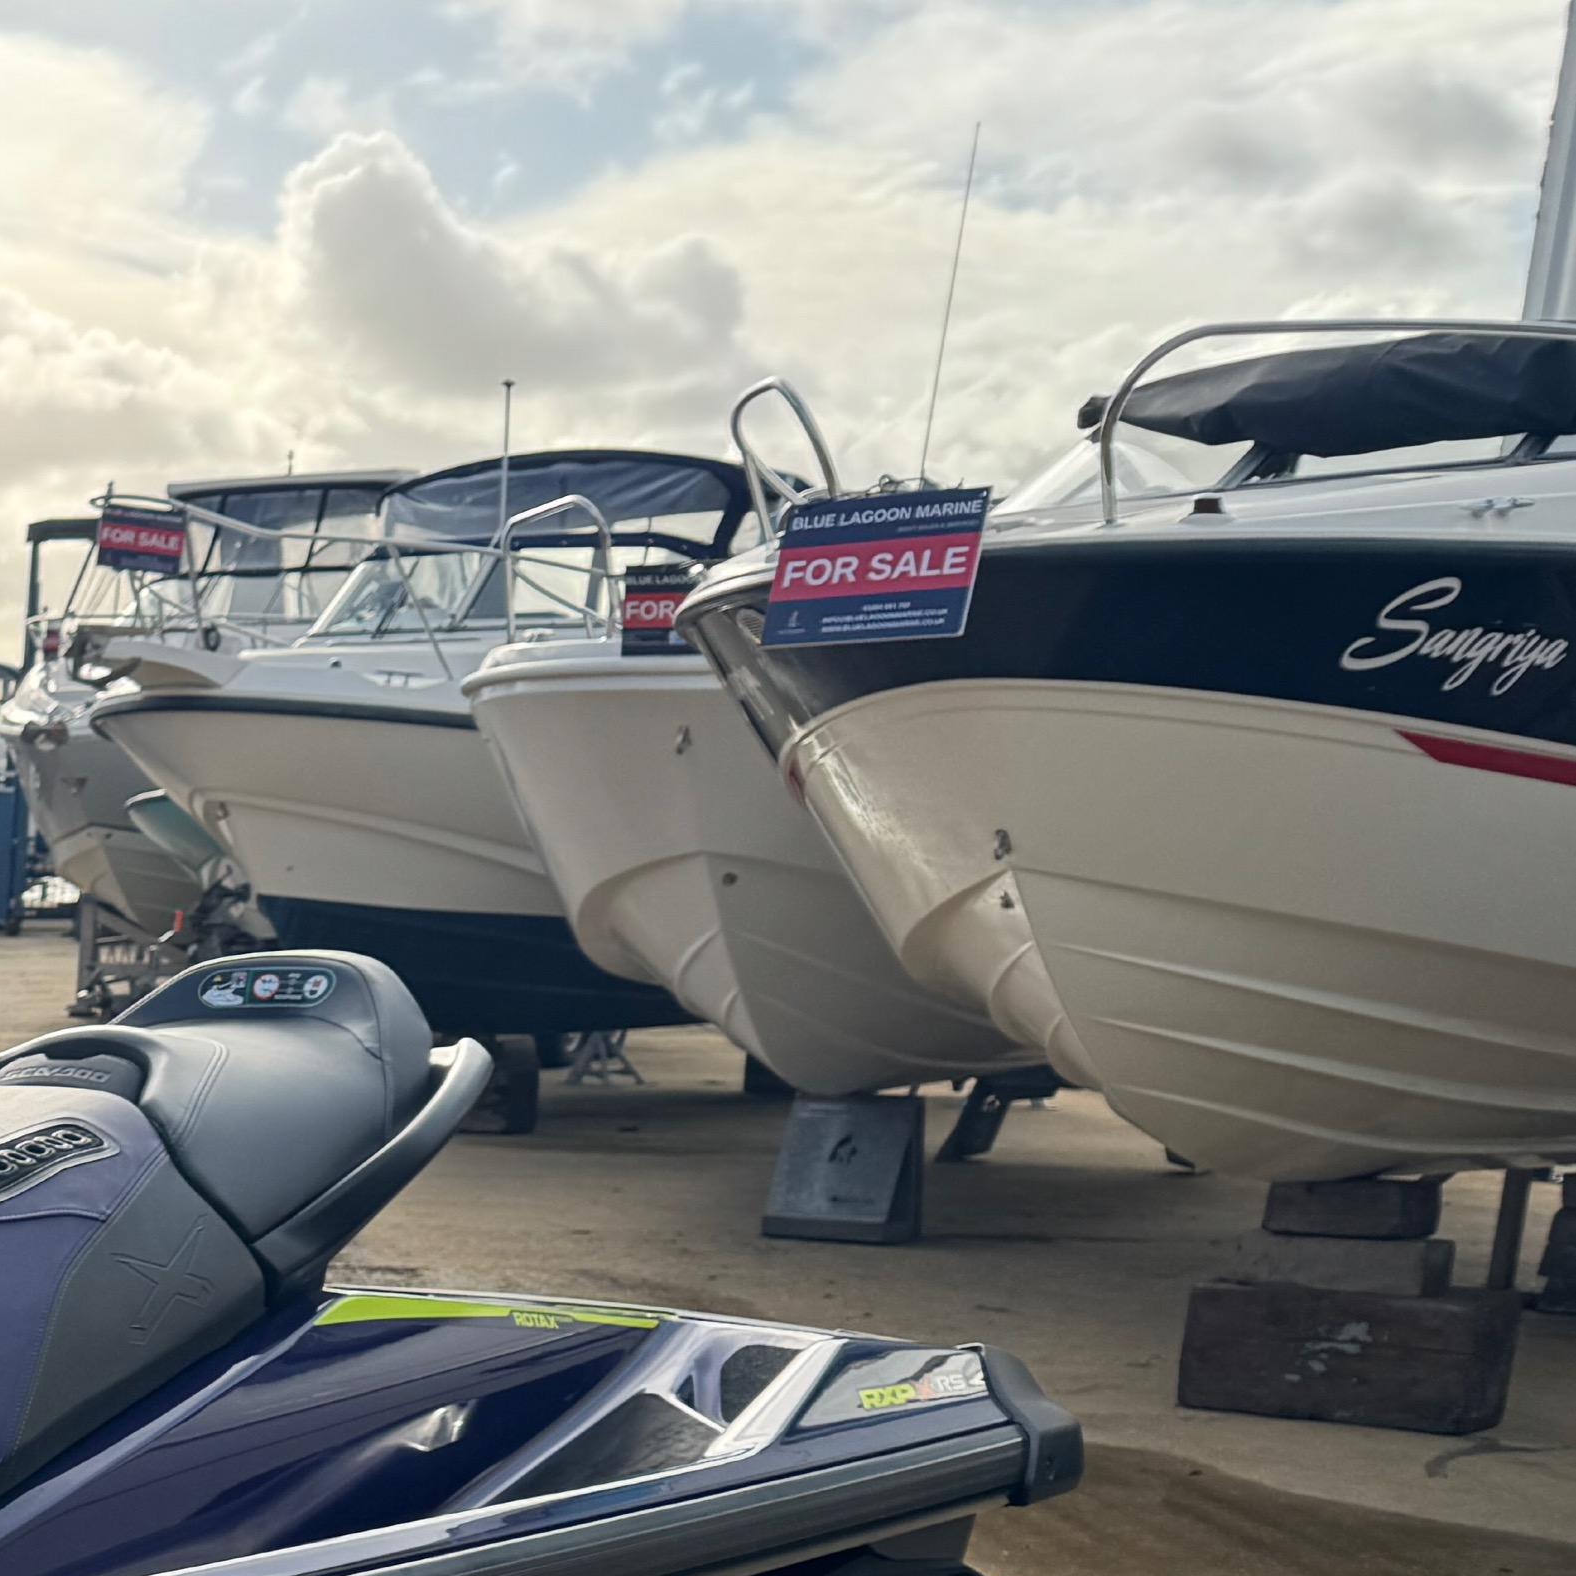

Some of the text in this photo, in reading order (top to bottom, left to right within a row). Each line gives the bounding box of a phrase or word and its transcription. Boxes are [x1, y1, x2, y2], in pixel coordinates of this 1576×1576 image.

[792, 513, 836, 531] BLUE
[839, 507, 912, 527] LAGOON
[915, 500, 983, 518] MARINE
[101, 527, 179, 550] FOR SALE
[781, 546, 970, 589] FOR SALE
[625, 600, 675, 620] FOR
[1339, 576, 1568, 696] Sangriya
